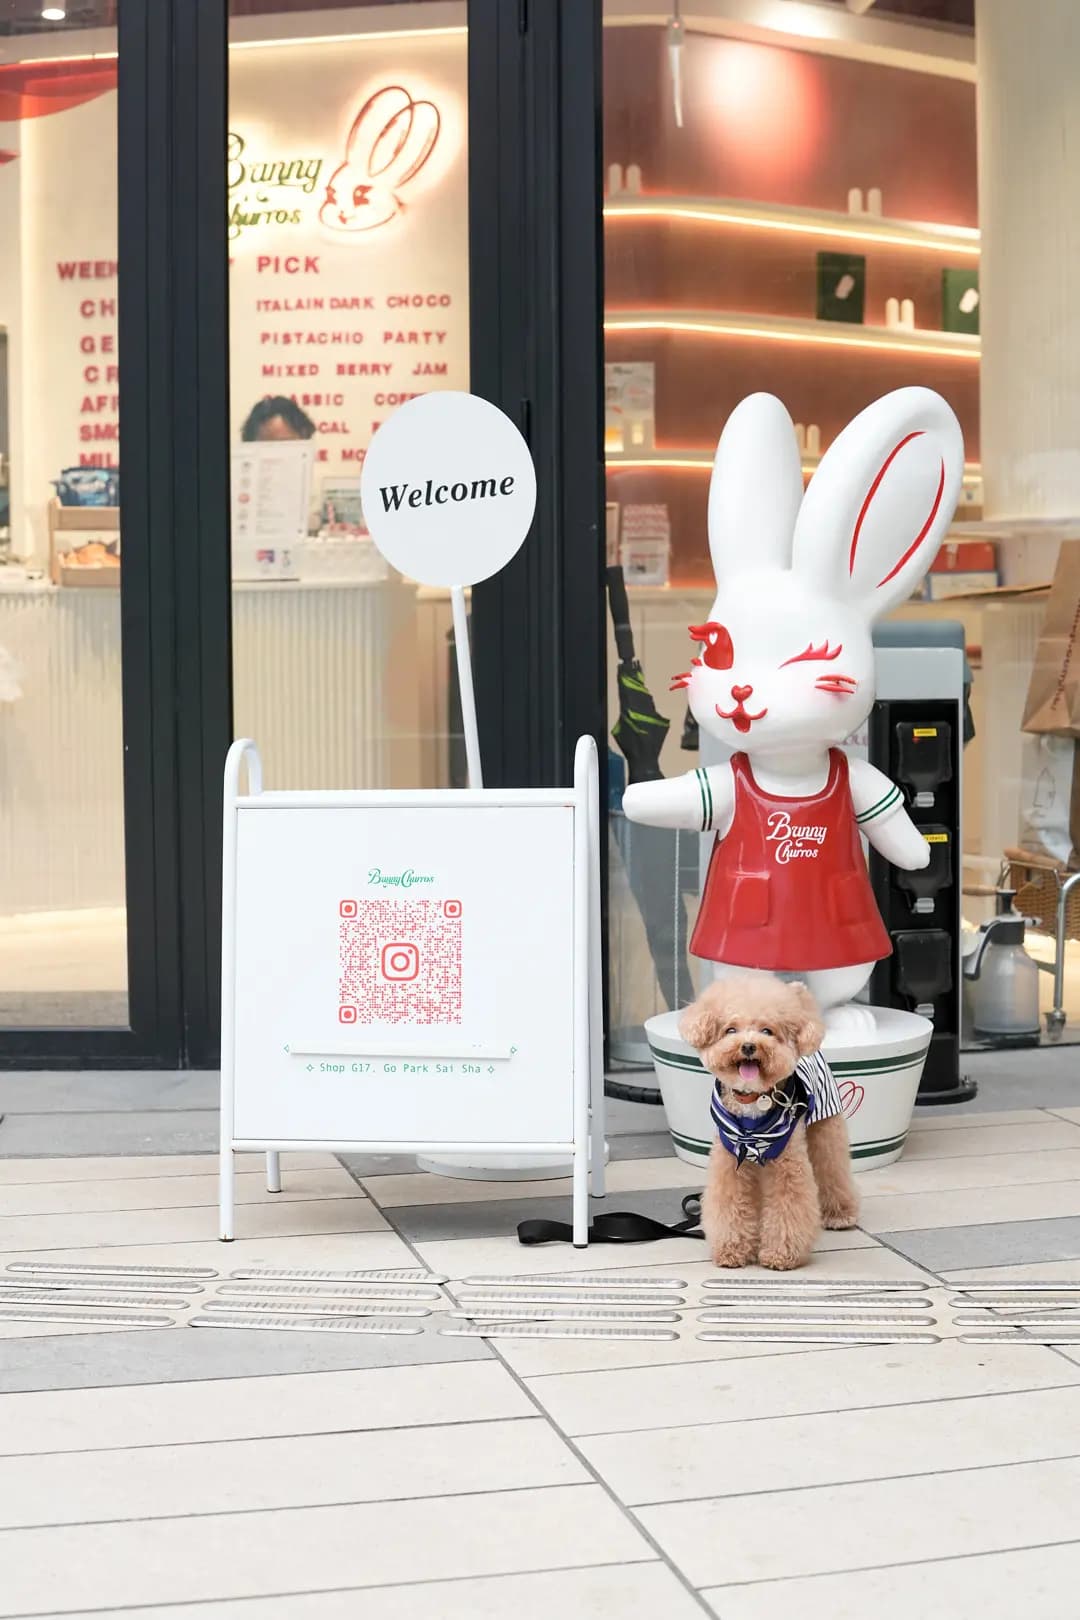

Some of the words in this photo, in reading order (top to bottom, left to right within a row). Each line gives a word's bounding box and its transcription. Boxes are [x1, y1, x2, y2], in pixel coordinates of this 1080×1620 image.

[257, 255, 320, 273] PICK
[80, 299, 115, 318] CH
[256, 297, 324, 312] ITALAIN
[330, 297, 375, 310] DARK
[386, 294, 451, 309] CHOCO
[80, 335, 113, 354] GE
[260, 331, 364, 345] PISTACHIO
[383, 331, 447, 345] PARTY
[262, 364, 319, 377] MIXED
[336, 363, 392, 376] BERRY
[412, 362, 448, 376] JAM
[379, 475, 515, 512] Welcome
[766, 811, 827, 847] Bunny
[775, 839, 819, 864] Churros
[320, 1062, 345, 1074] Shop
[383, 1063, 397, 1073] Go
[403, 1063, 428, 1073] Park
[436, 1063, 453, 1073] Sai
[462, 1063, 481, 1073] Sha
